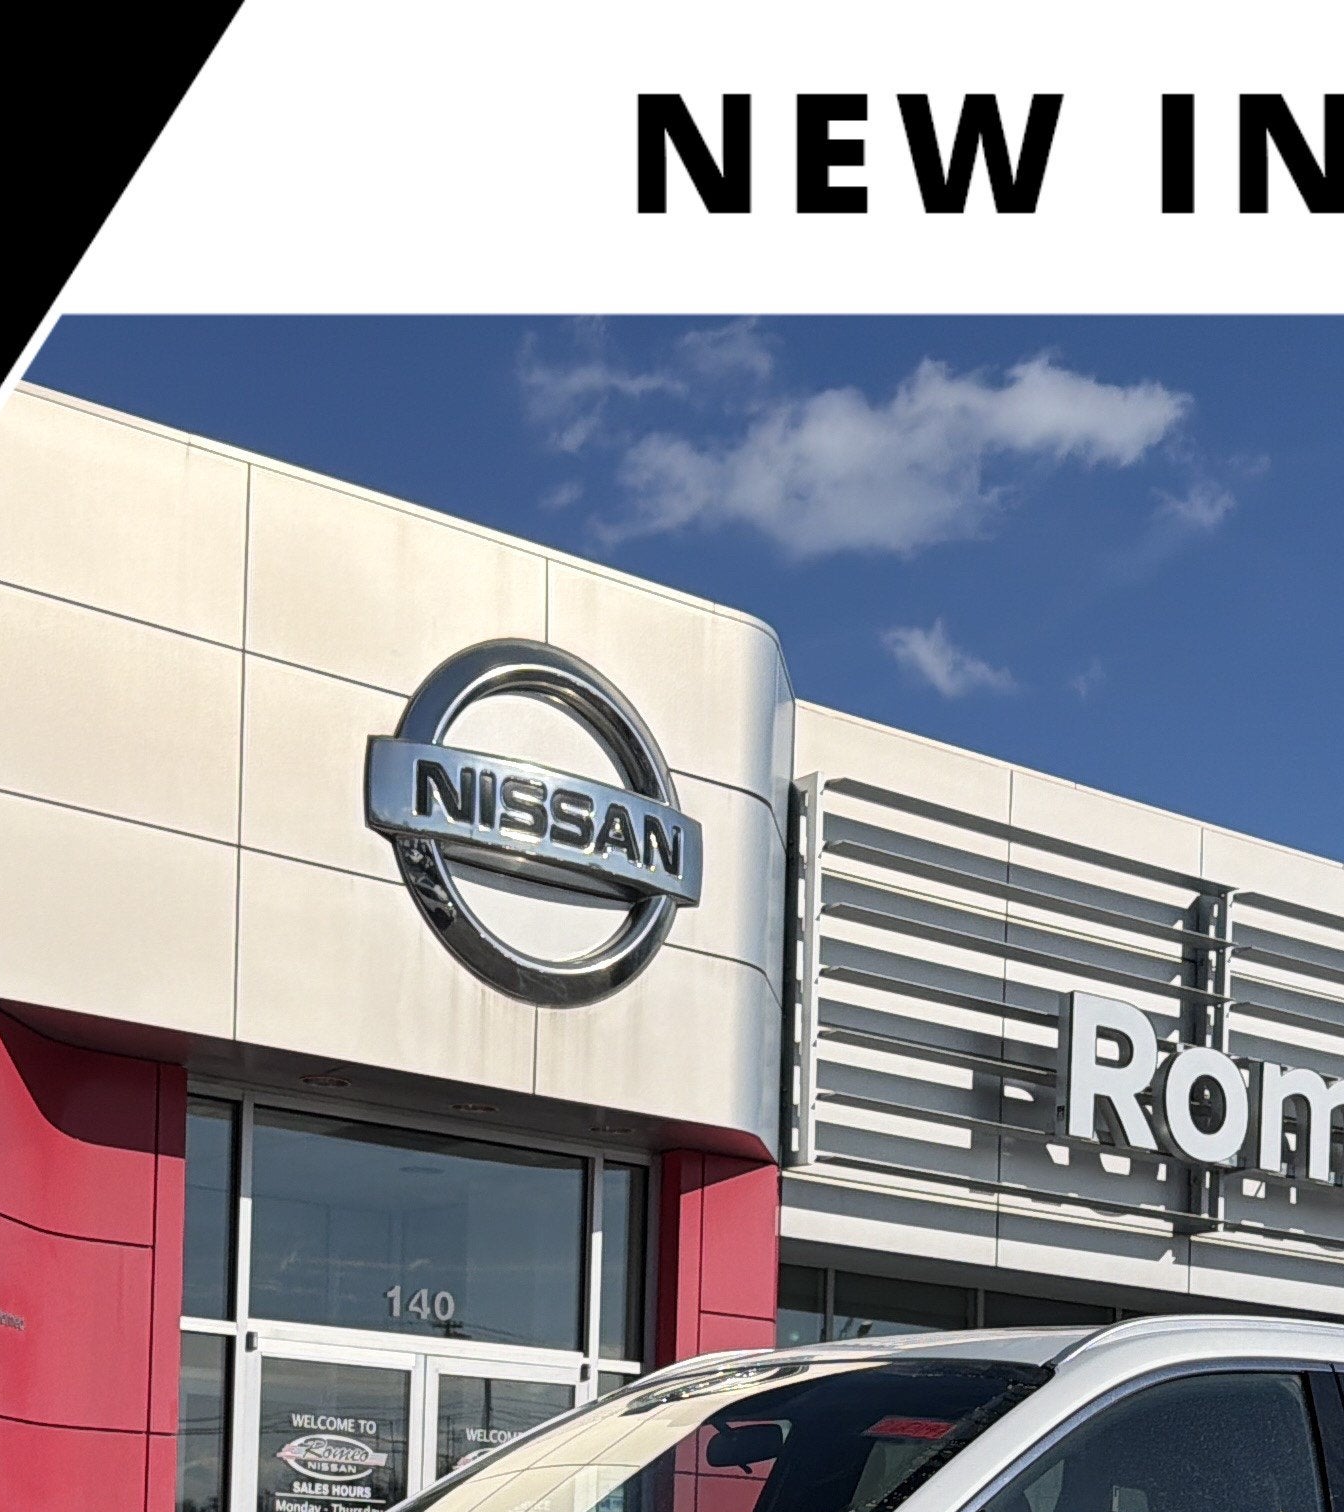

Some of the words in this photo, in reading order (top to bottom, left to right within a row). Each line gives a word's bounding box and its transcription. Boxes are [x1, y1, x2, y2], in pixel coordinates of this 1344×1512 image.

[412, 758, 684, 880] NISSAN
[385, 1285, 455, 1321] 140
[291, 1413, 356, 1434] WELCOME
[358, 1419, 377, 1435] TO
[465, 1427, 524, 1443] WELCOM
[302, 1437, 369, 1463] Romeo
[307, 1461, 357, 1474] NISSAN
[292, 1481, 329, 1496] SALES
[332, 1483, 372, 1499] HOURS
